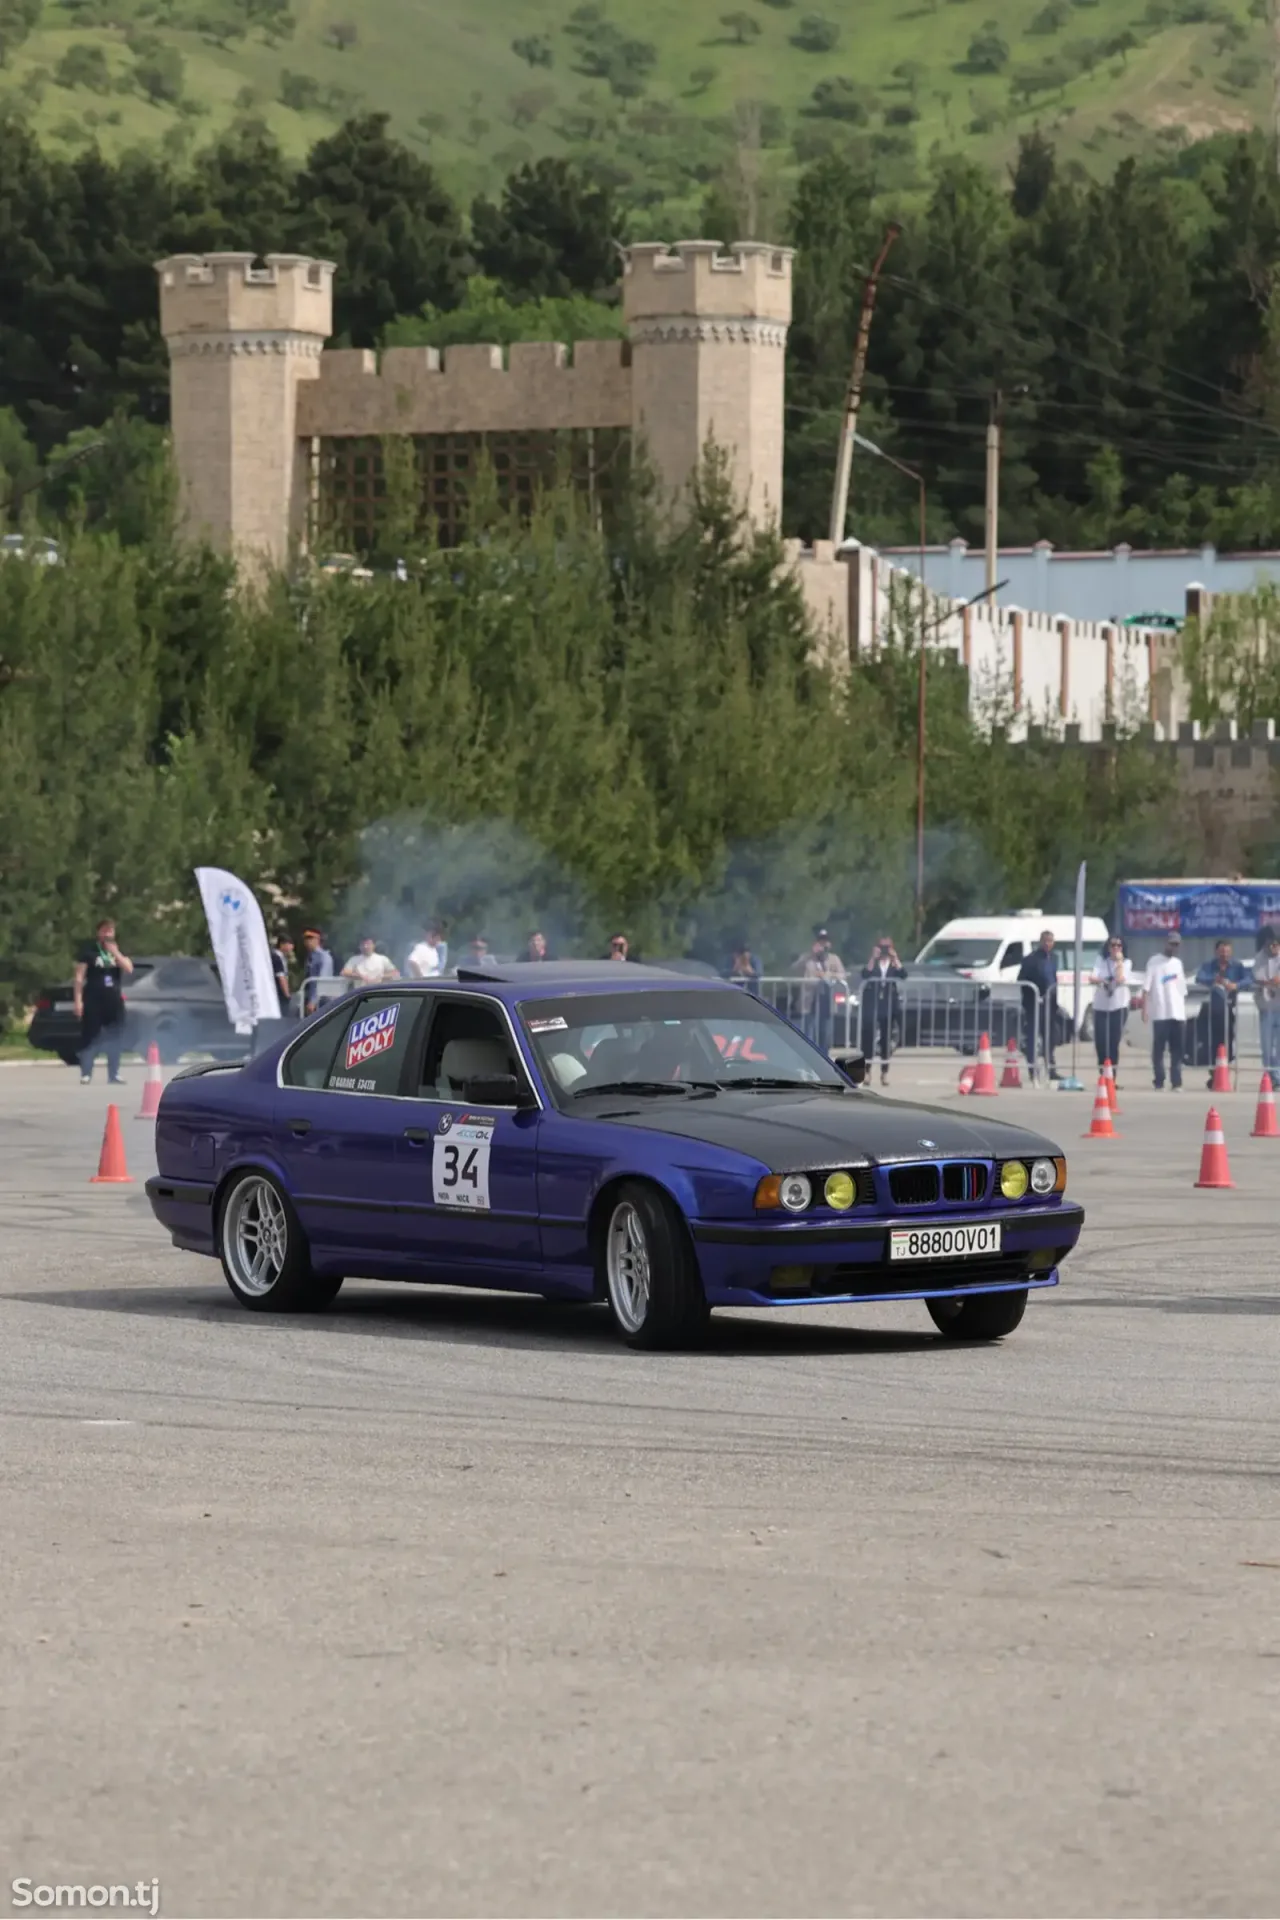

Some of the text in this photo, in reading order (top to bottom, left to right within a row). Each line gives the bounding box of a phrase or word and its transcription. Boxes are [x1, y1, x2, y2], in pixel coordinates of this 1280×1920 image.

[350, 1007, 397, 1044] LIQUI
[348, 1027, 394, 1065] MOLY
[443, 1145, 479, 1188] 34
[895, 1246, 906, 1257] TJ
